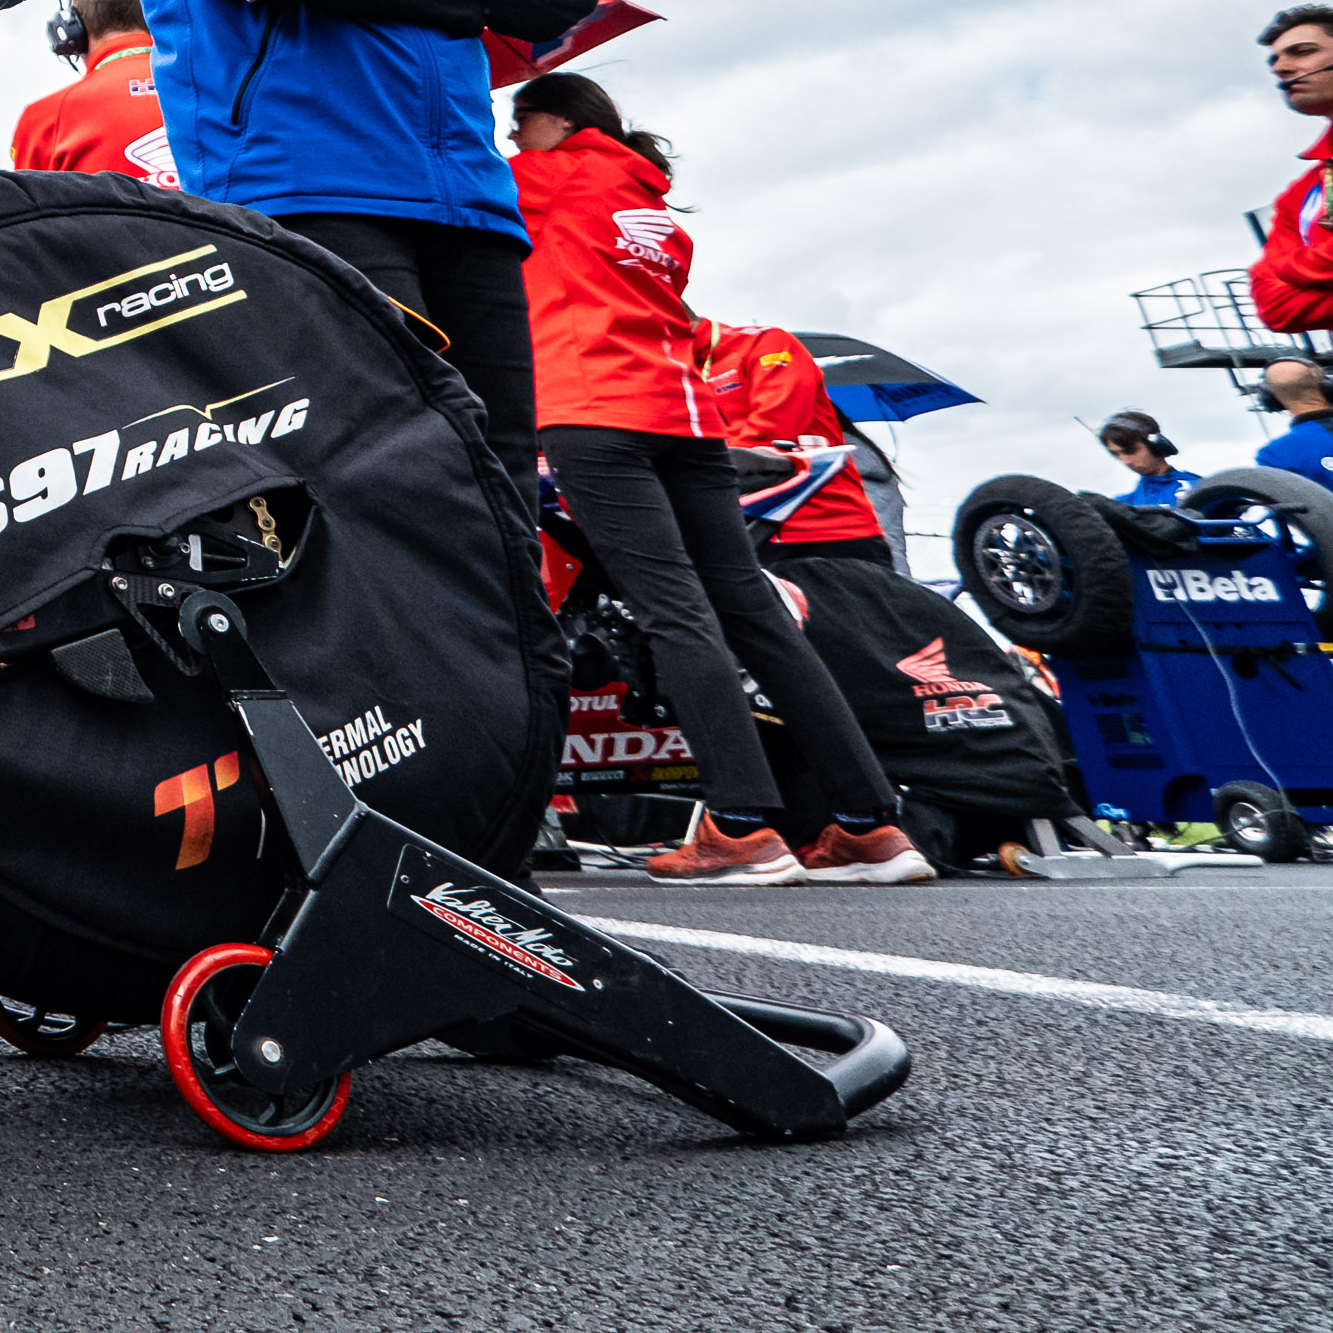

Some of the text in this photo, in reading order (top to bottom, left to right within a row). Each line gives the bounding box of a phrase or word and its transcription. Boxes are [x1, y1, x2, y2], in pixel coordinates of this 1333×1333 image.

[95, 261, 235, 328] racing
[1181, 568, 1282, 602] Beta
[570, 694, 619, 713] OTUL
[911, 680, 994, 698] HONDA
[317, 705, 393, 762] ERMAL
[333, 718, 427, 788] NOLOGY
[561, 728, 696, 765] NDA
[432, 906, 564, 982] COMPONENTS
[453, 933, 535, 979] MADE IN ITALY
